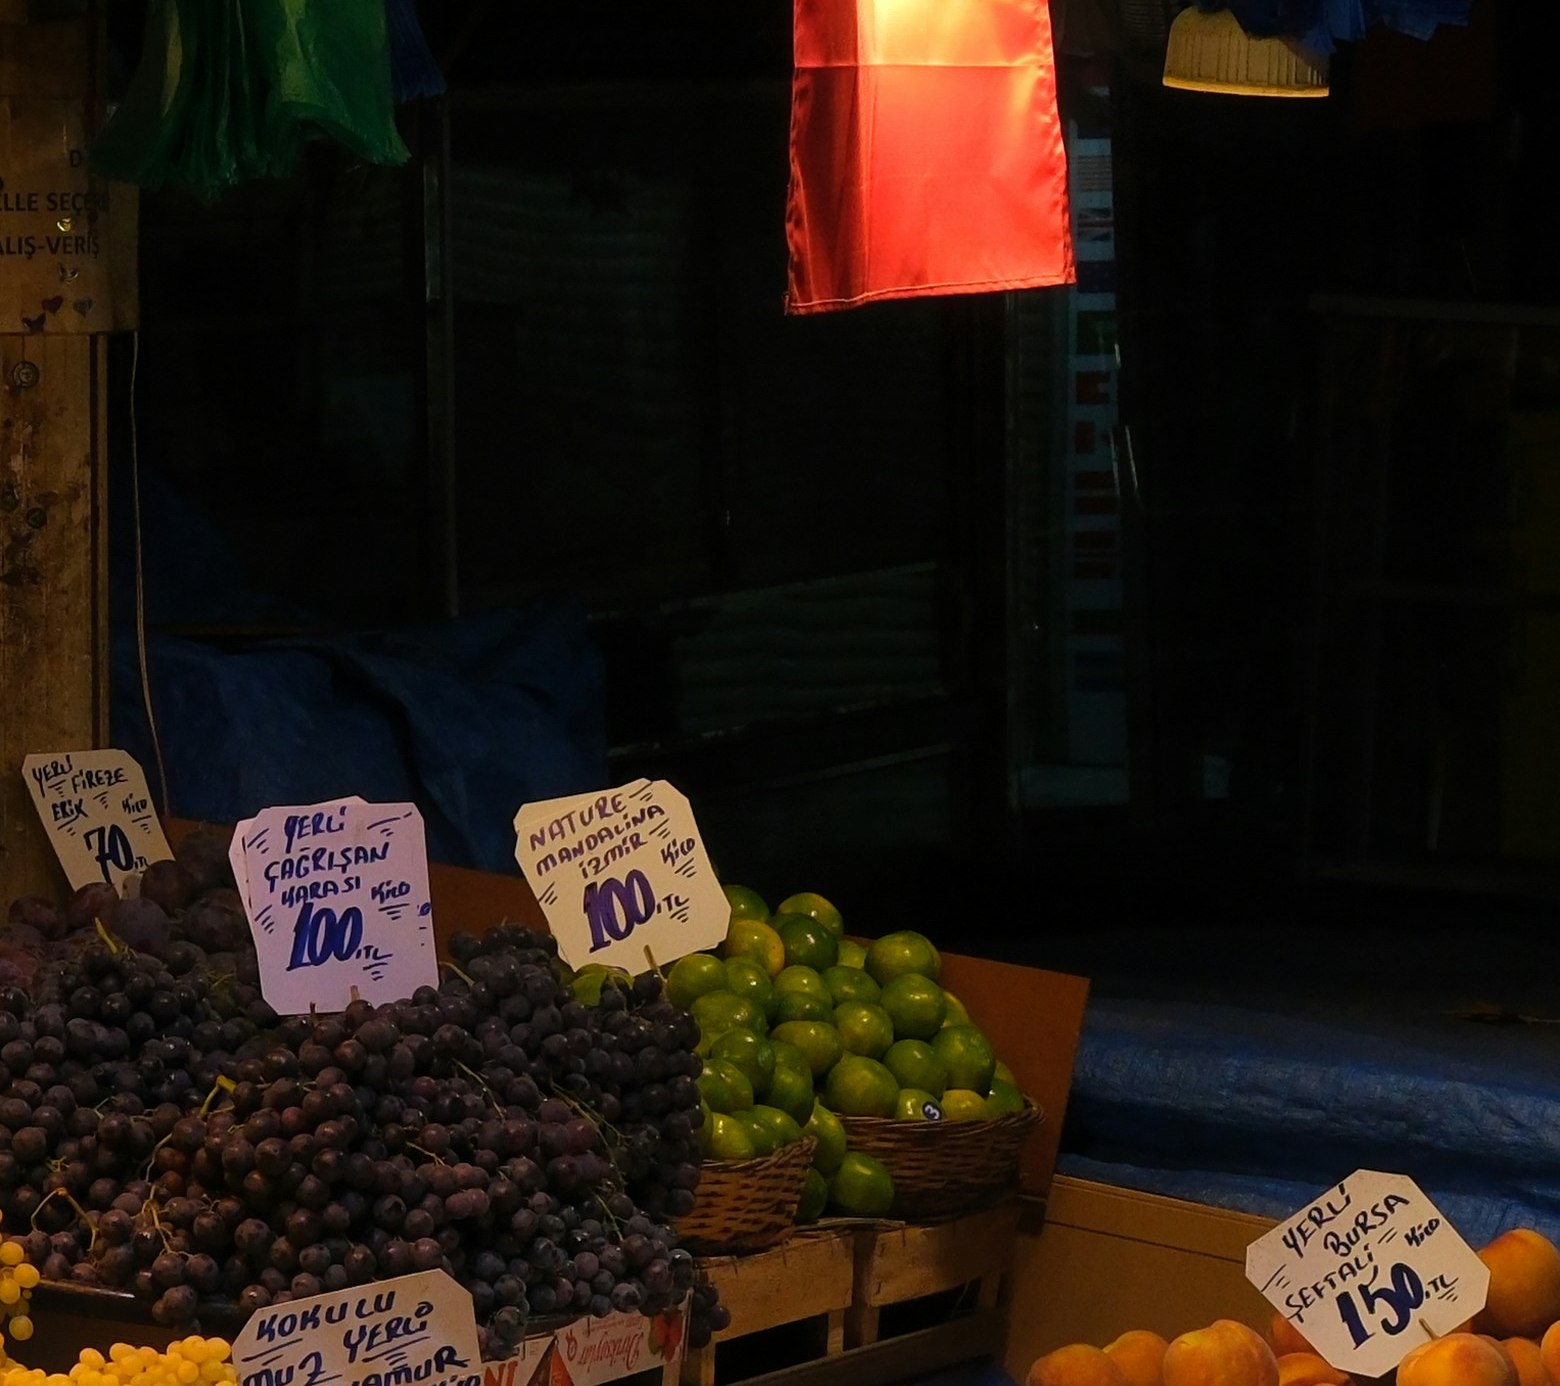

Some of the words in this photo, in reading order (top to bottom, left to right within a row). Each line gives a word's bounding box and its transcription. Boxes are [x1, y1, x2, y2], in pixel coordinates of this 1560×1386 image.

[529, 793, 628, 852] NATURE
[536, 805, 667, 877] MANDALİNA
[83, 824, 135, 885] 70
[578, 831, 648, 880] İZMİR
[281, 876, 362, 909] KARASI
[582, 868, 656, 954] 100
[285, 902, 364, 972] 100
[1323, 1194, 1411, 1257] BURSA
[1284, 1242, 1375, 1324] ŞEFTALİ
[1336, 1262, 1425, 1351] 150
[256, 1290, 397, 1343] KOKULU
